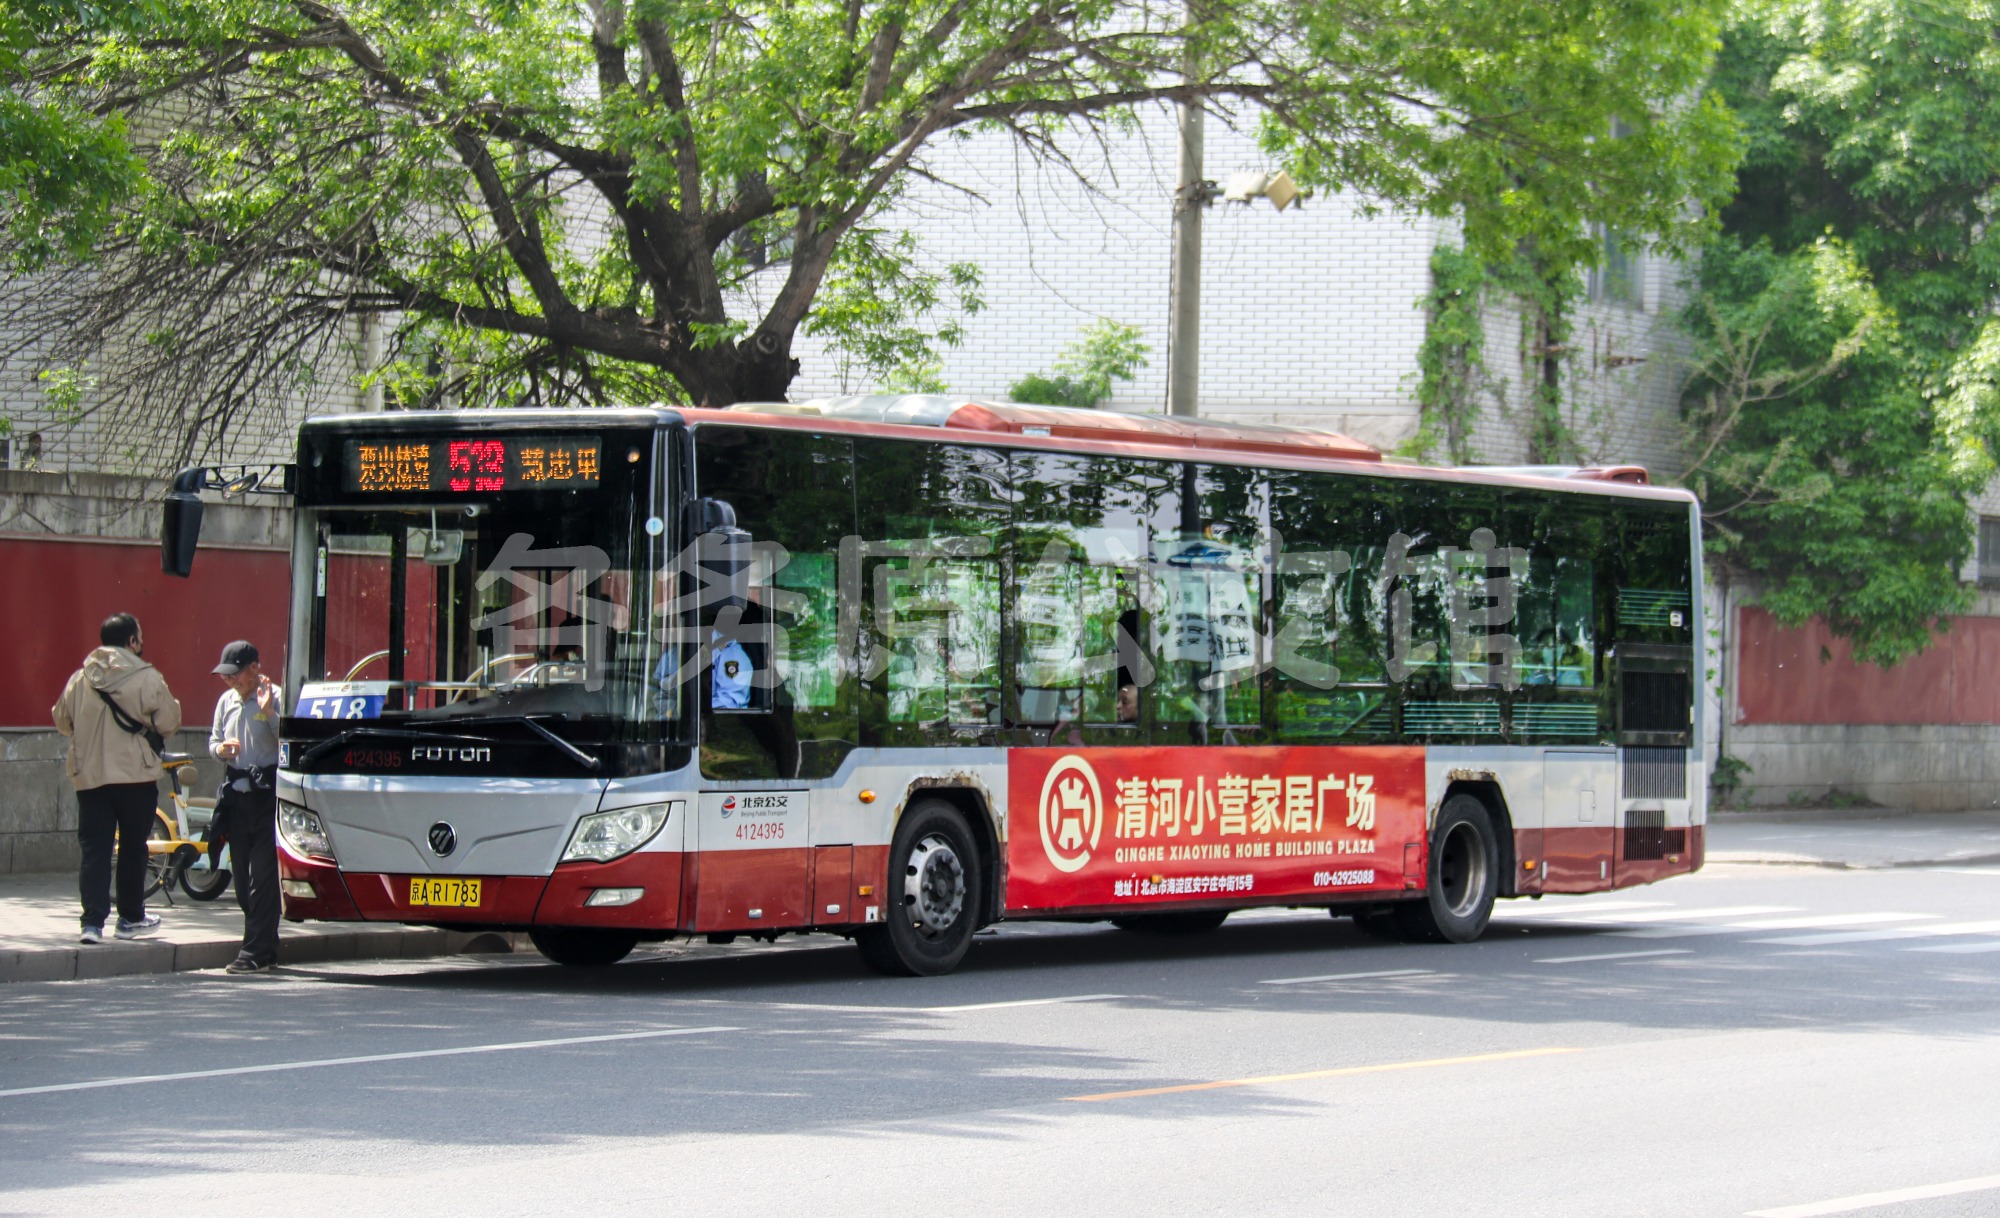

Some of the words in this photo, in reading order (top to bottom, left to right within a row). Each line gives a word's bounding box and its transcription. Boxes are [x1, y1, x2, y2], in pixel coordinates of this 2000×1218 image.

[310, 697, 367, 719] 518
[344, 751, 401, 768] 4124395
[411, 746, 491, 762] FOTON
[742, 796, 788, 808] 北京公交
[1114, 772, 1376, 839] 清河小营家居广场
[736, 823, 784, 840] 4124395
[1115, 845, 1165, 863] QINGHE
[1169, 843, 1231, 861] XIAOYING
[1235, 842, 1271, 859] HOME
[1275, 841, 1333, 857] BUILDING
[1337, 839, 1375, 854] PLAZA
[1313, 870, 1375, 887] 010-62925088
